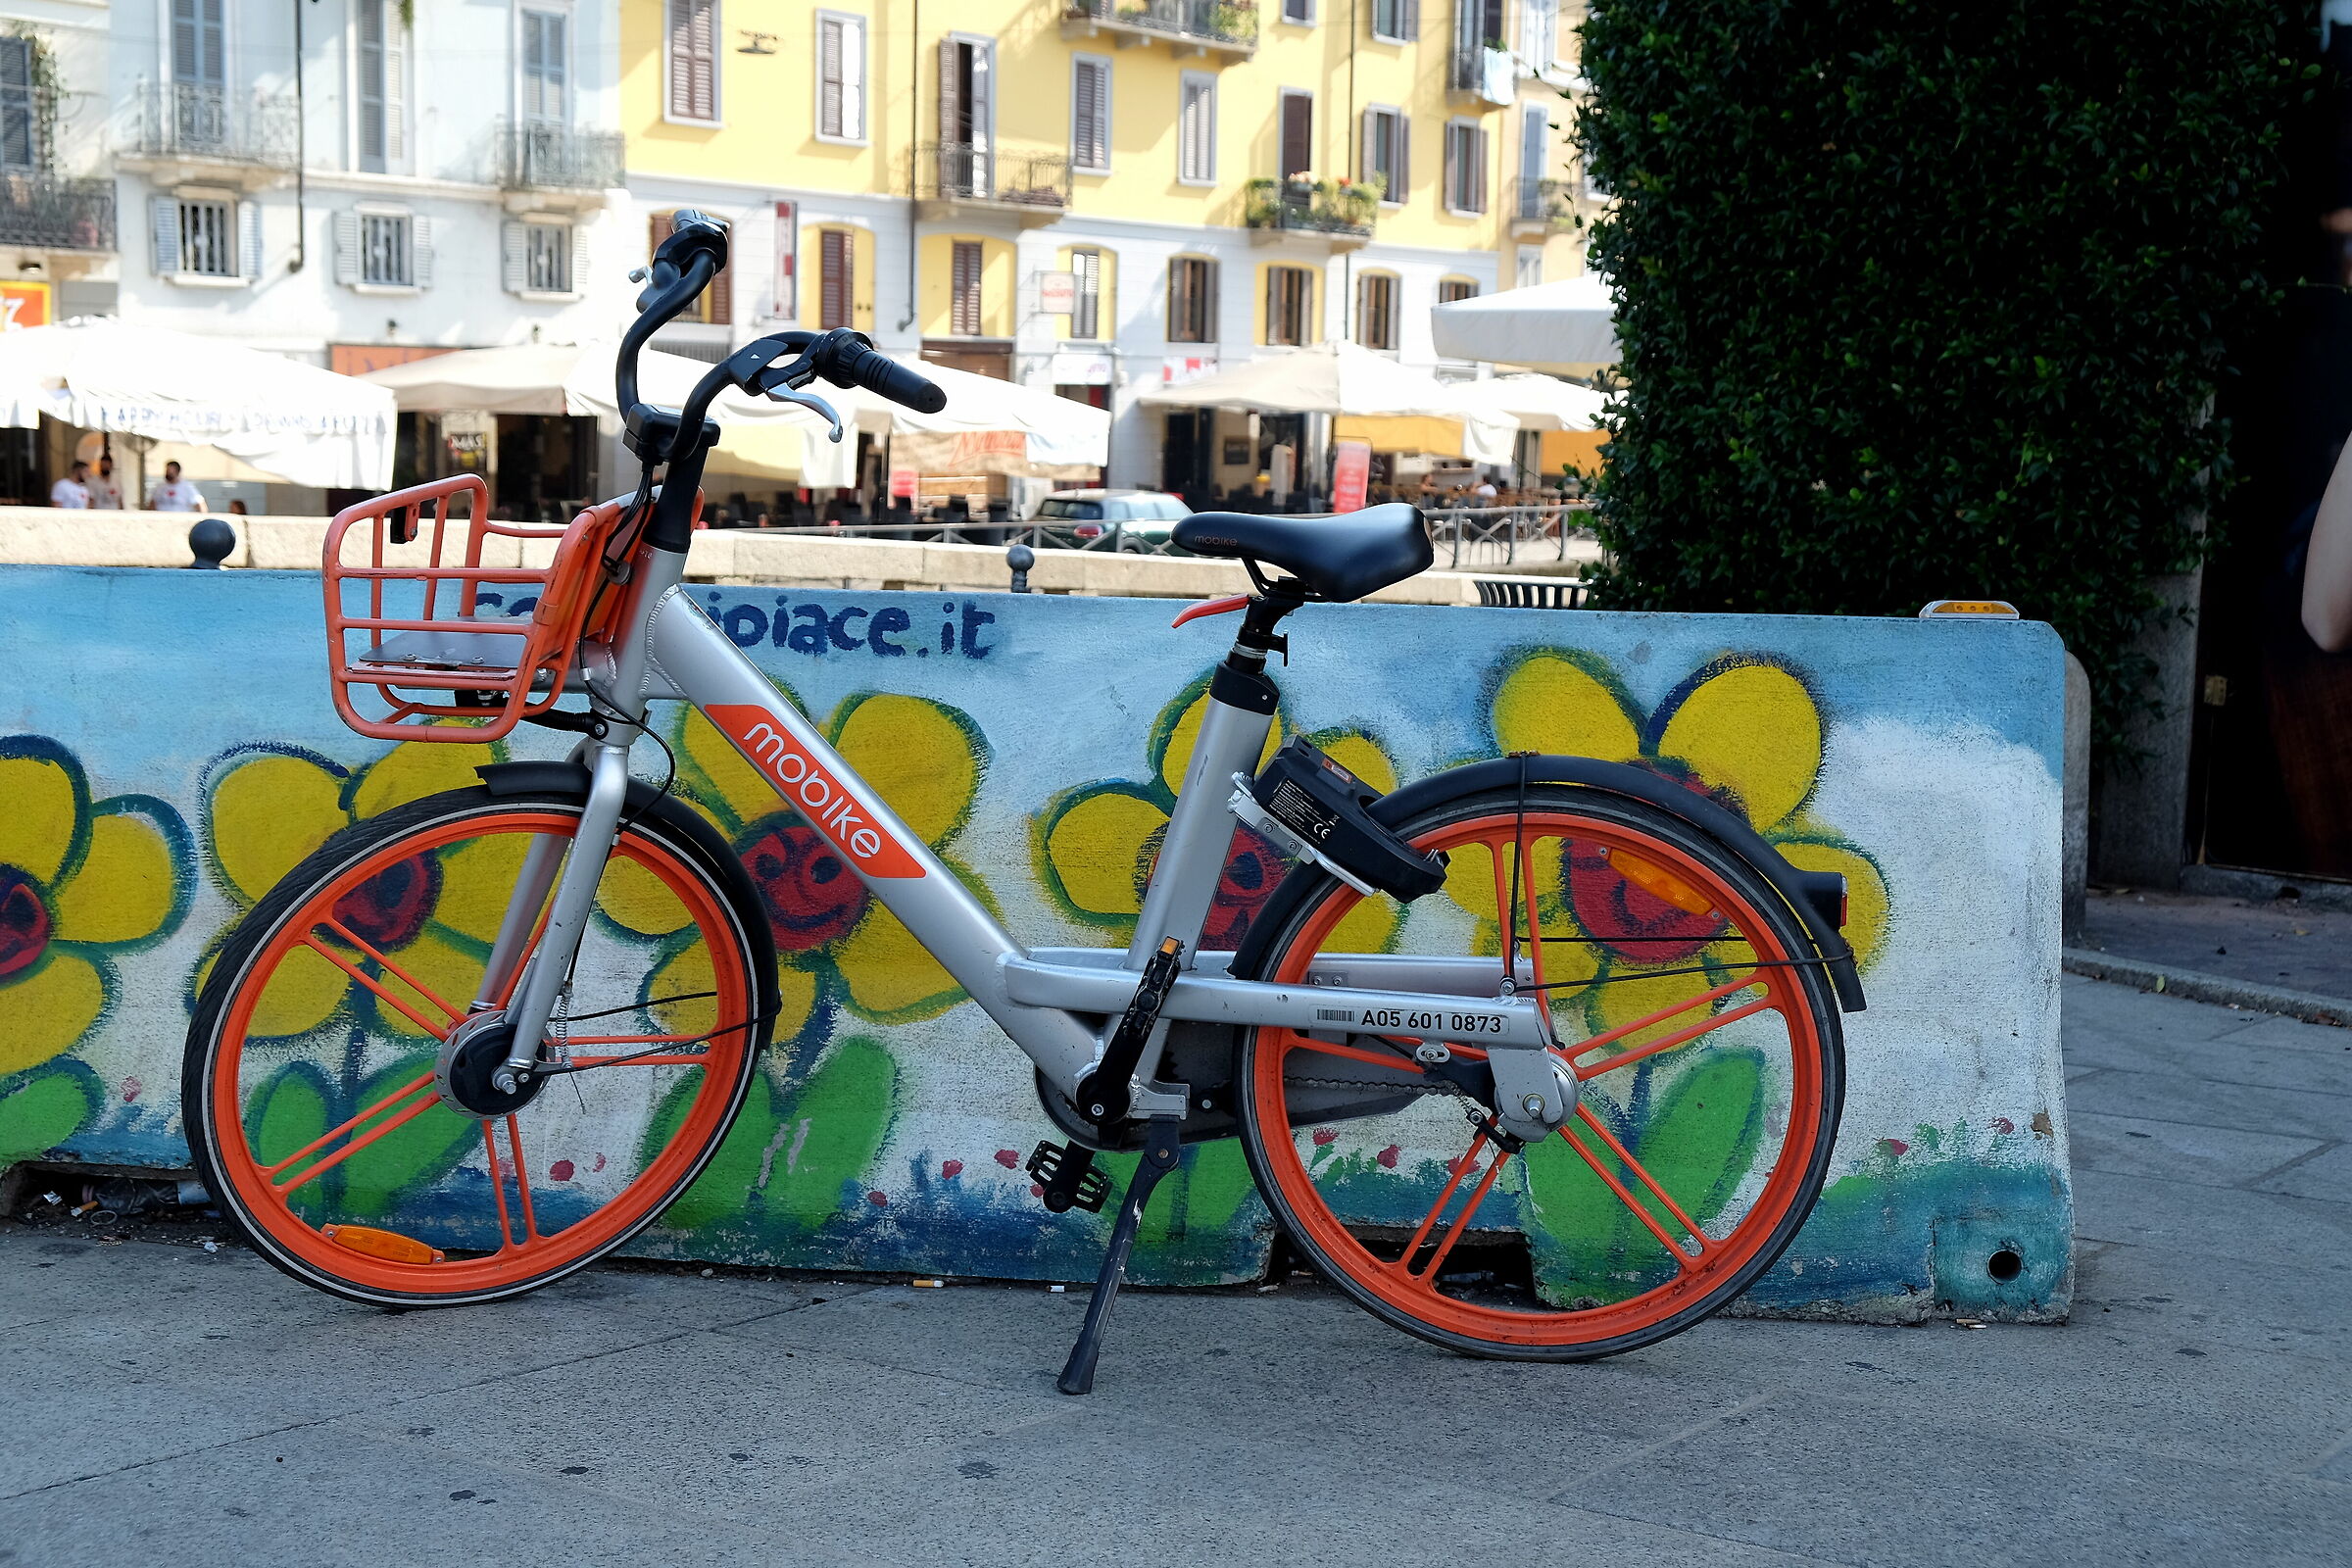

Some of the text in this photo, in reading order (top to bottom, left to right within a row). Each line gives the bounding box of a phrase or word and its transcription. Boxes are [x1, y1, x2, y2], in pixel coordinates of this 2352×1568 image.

[1194, 534, 1239, 547] mobike
[743, 722, 881, 858] mobike
[1360, 1009, 1501, 1034] A05 601 0873
